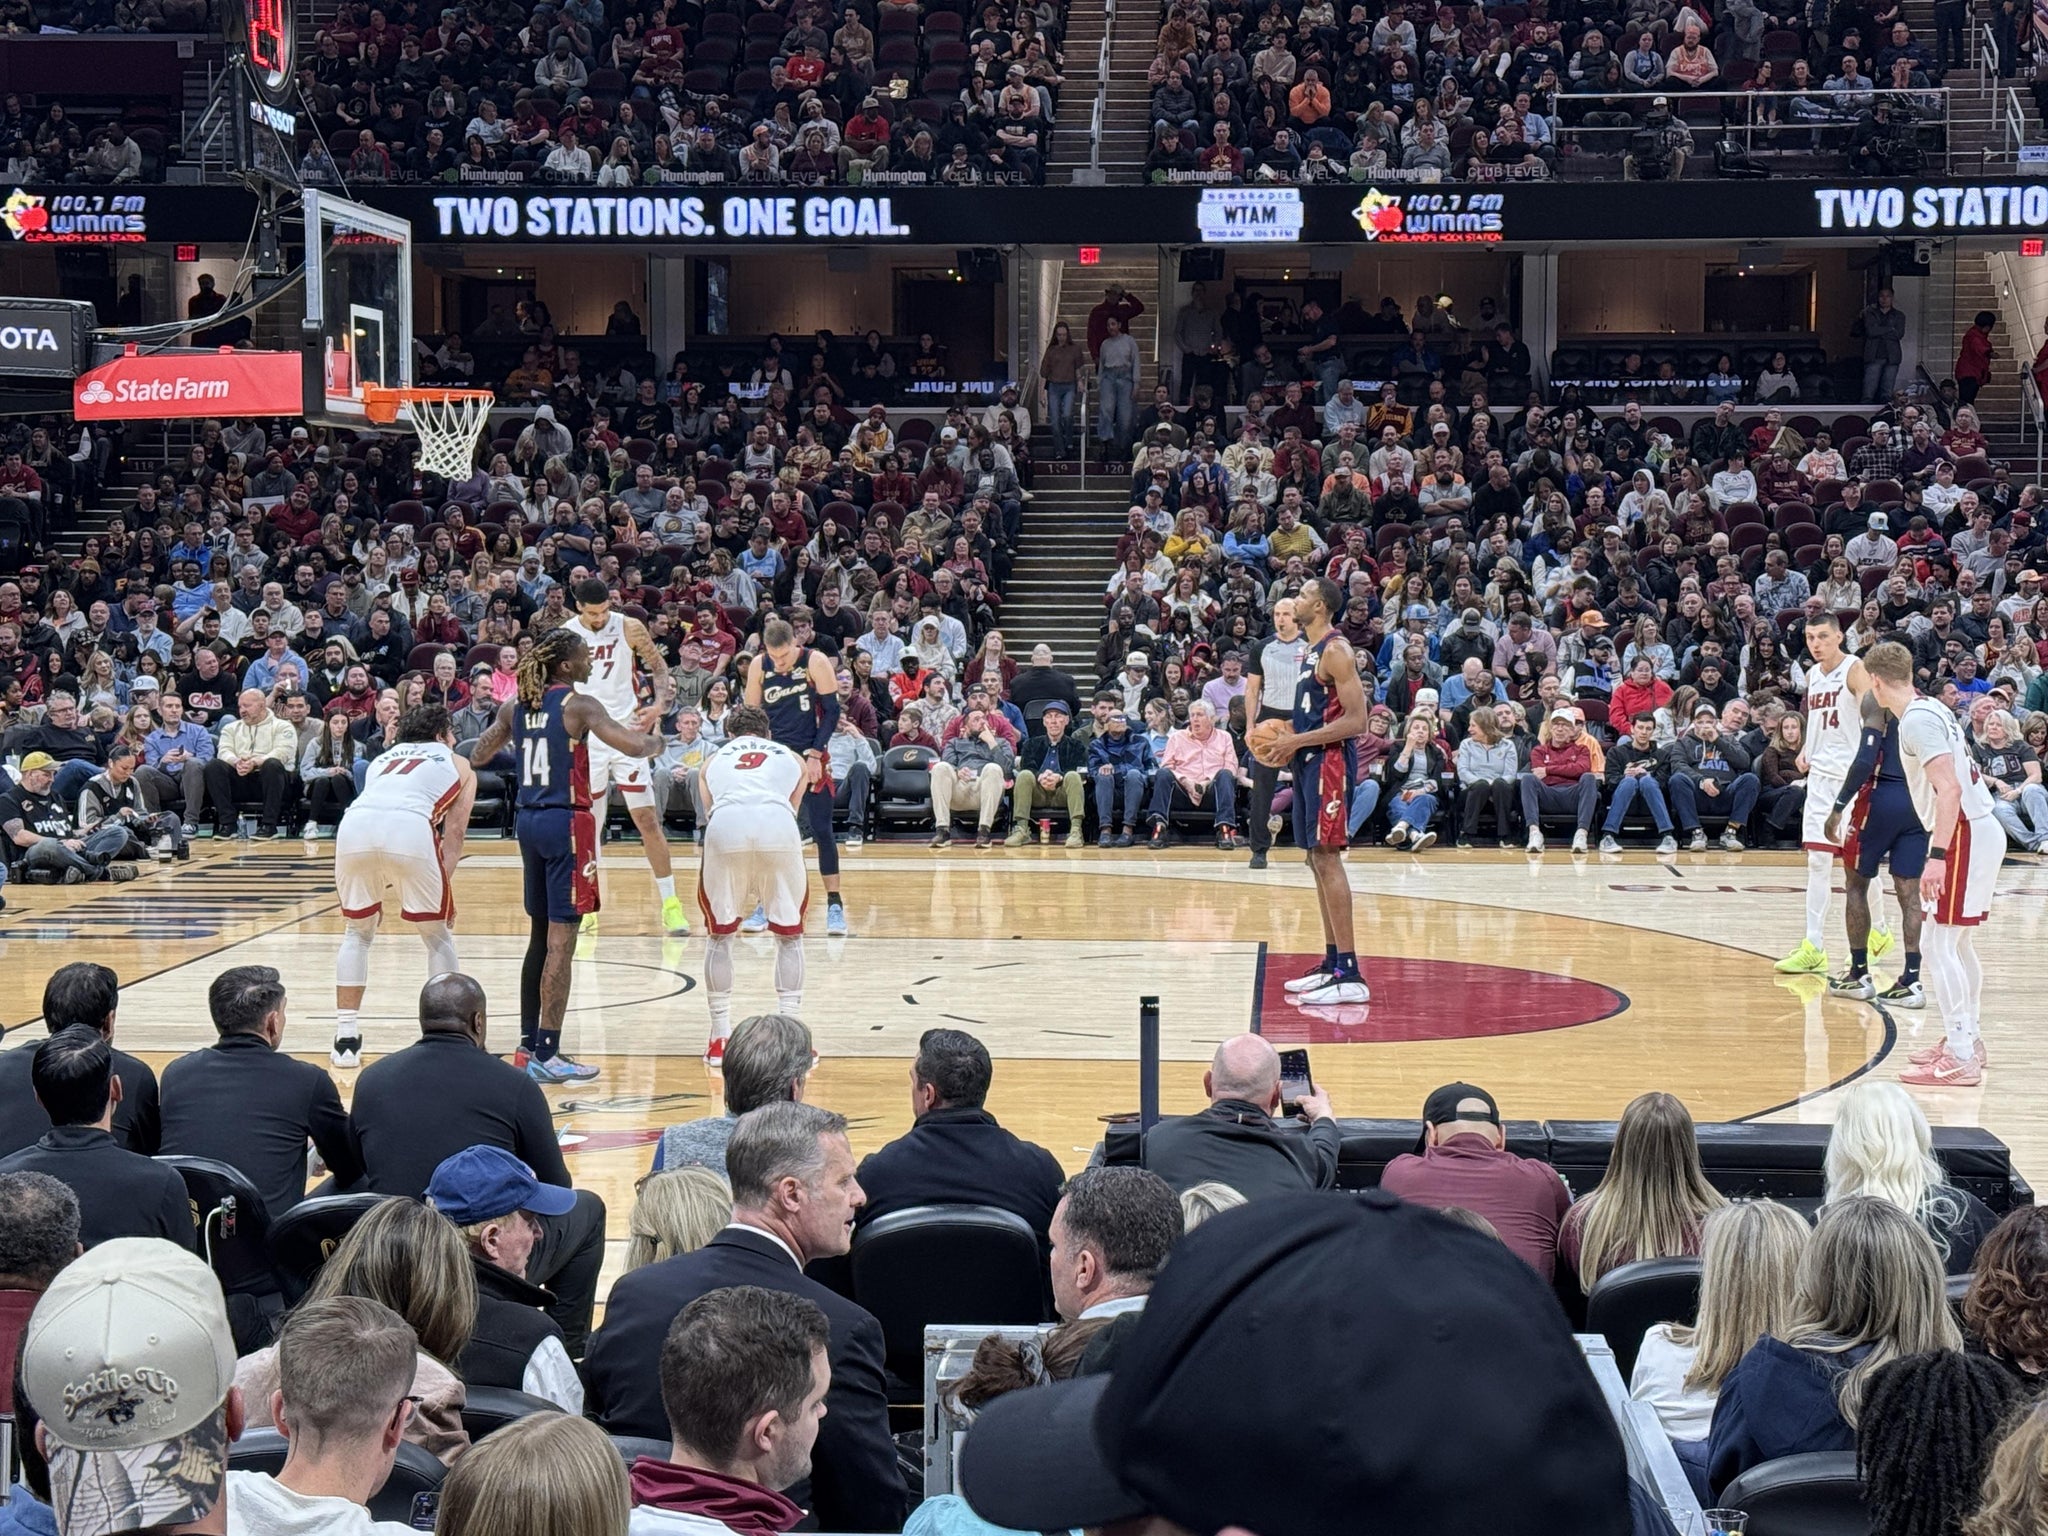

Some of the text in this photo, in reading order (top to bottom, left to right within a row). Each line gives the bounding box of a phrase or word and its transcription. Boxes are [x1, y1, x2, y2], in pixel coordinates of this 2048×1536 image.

[460, 167, 524, 184] Huntington
[661, 169, 724, 185] Huntington
[862, 169, 926, 185] Huntington
[987, 171, 1026, 182] LEVEL
[1168, 168, 1232, 184] Huntington
[1467, 166, 1550, 178] CLUB LEVEL
[52, 196, 146, 212] 100.7 FM
[1407, 194, 1504, 212] 100.7 FM
[1814, 185, 2048, 229] TWO STATIO
[433, 197, 519, 236] TWO
[526, 196, 715, 236] STATIONS.
[723, 197, 797, 236] ONE
[804, 196, 910, 236] GOAL.
[1224, 206, 1277, 224] WTAM
[2022, 239, 2044, 256] EXIT
[1104, 464, 1124, 474] 120
[602, 661, 615, 680] 7
[799, 694, 811, 712] 5
[1301, 691, 1312, 714] 4
[1809, 685, 1844, 710] HEAT
[1822, 709, 1840, 730] 14
[375, 758, 428, 778] 11
[522, 737, 551, 787] 14
[734, 751, 768, 770] 9
[63, 1366, 179, 1420] Saddle Up
